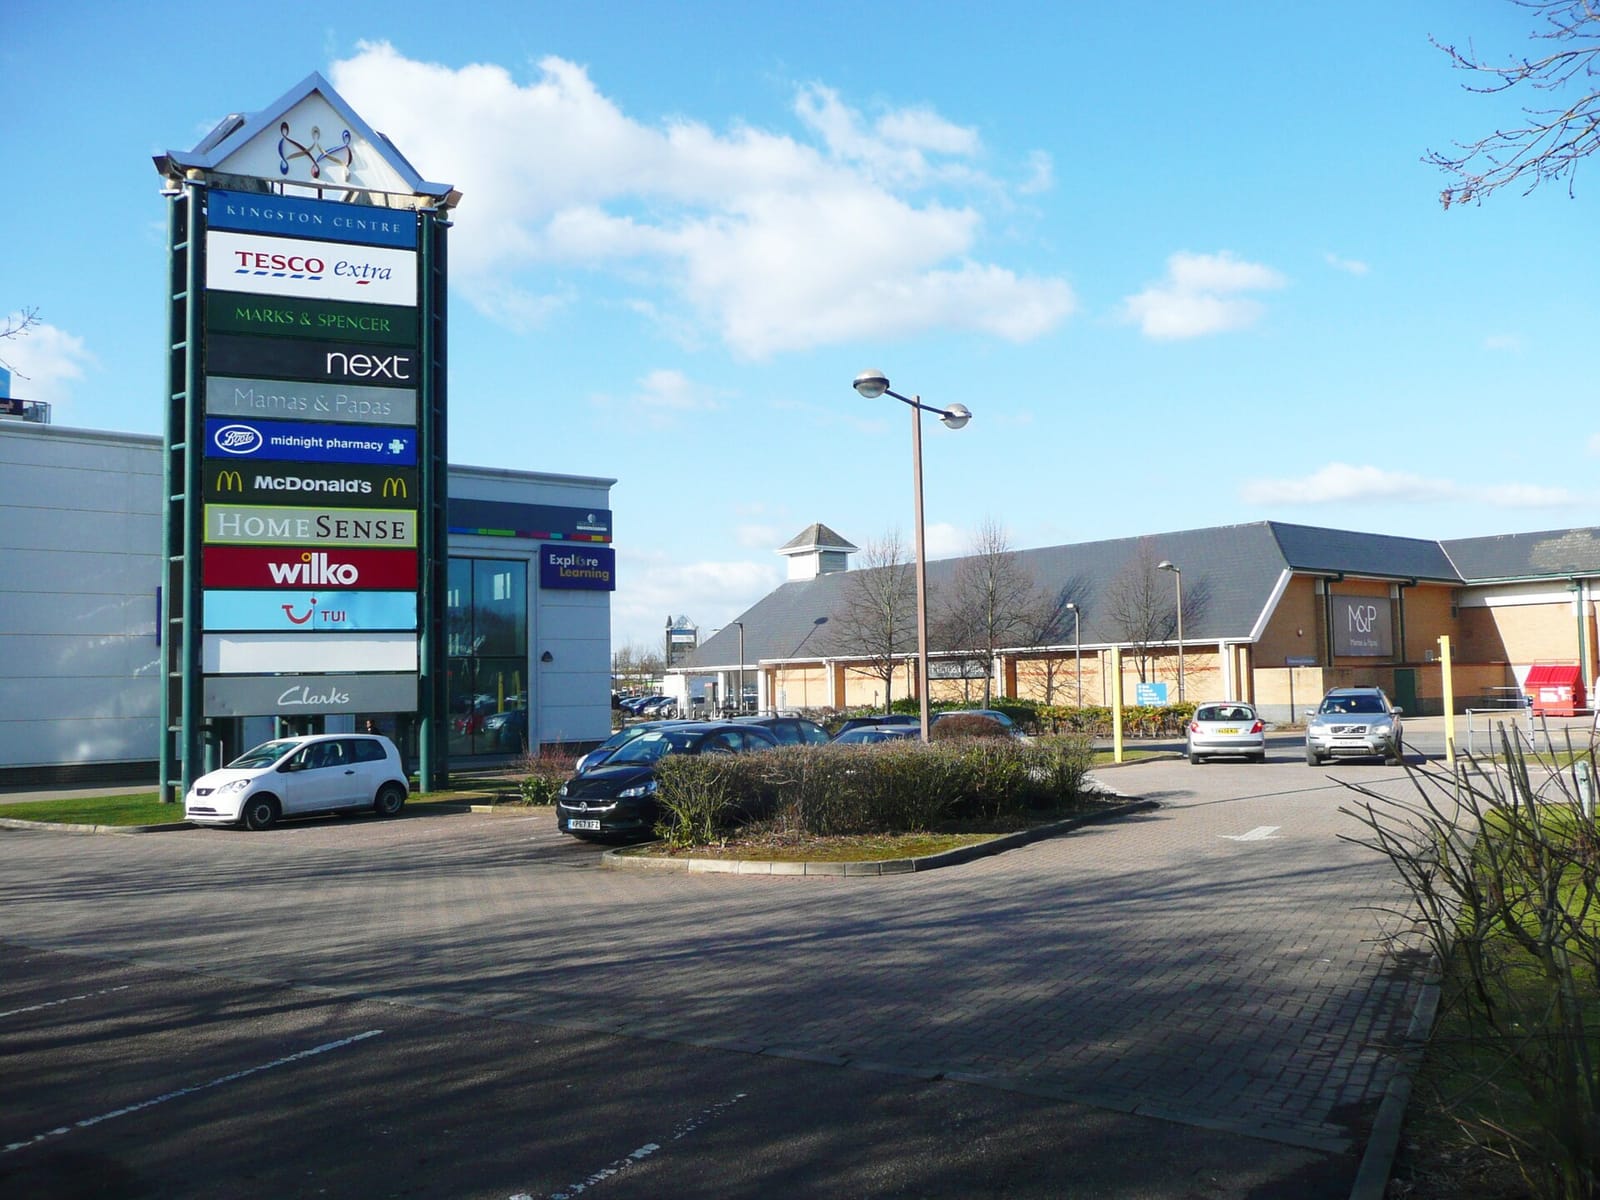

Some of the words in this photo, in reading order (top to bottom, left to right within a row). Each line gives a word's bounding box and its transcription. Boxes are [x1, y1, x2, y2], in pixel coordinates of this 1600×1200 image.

[226, 204, 323, 225] KINGSTON
[333, 217, 401, 233] CENTRE
[235, 251, 325, 273] TESCO
[334, 260, 392, 281] extra
[235, 308, 294, 325] MARKS
[299, 312, 312, 327] &
[318, 313, 391, 332] SPENCER
[327, 352, 410, 379] next
[234, 388, 308, 411] Mamas
[313, 394, 330, 412] &
[335, 394, 392, 418] Papas
[270, 435, 323, 449] midnight
[326, 437, 384, 452] pharmacy
[254, 475, 373, 494] McDonald's
[268, 552, 359, 585] wilko
[560, 567, 609, 581] Learning
[320, 610, 346, 623] TUI
[277, 686, 350, 706] Clarks
